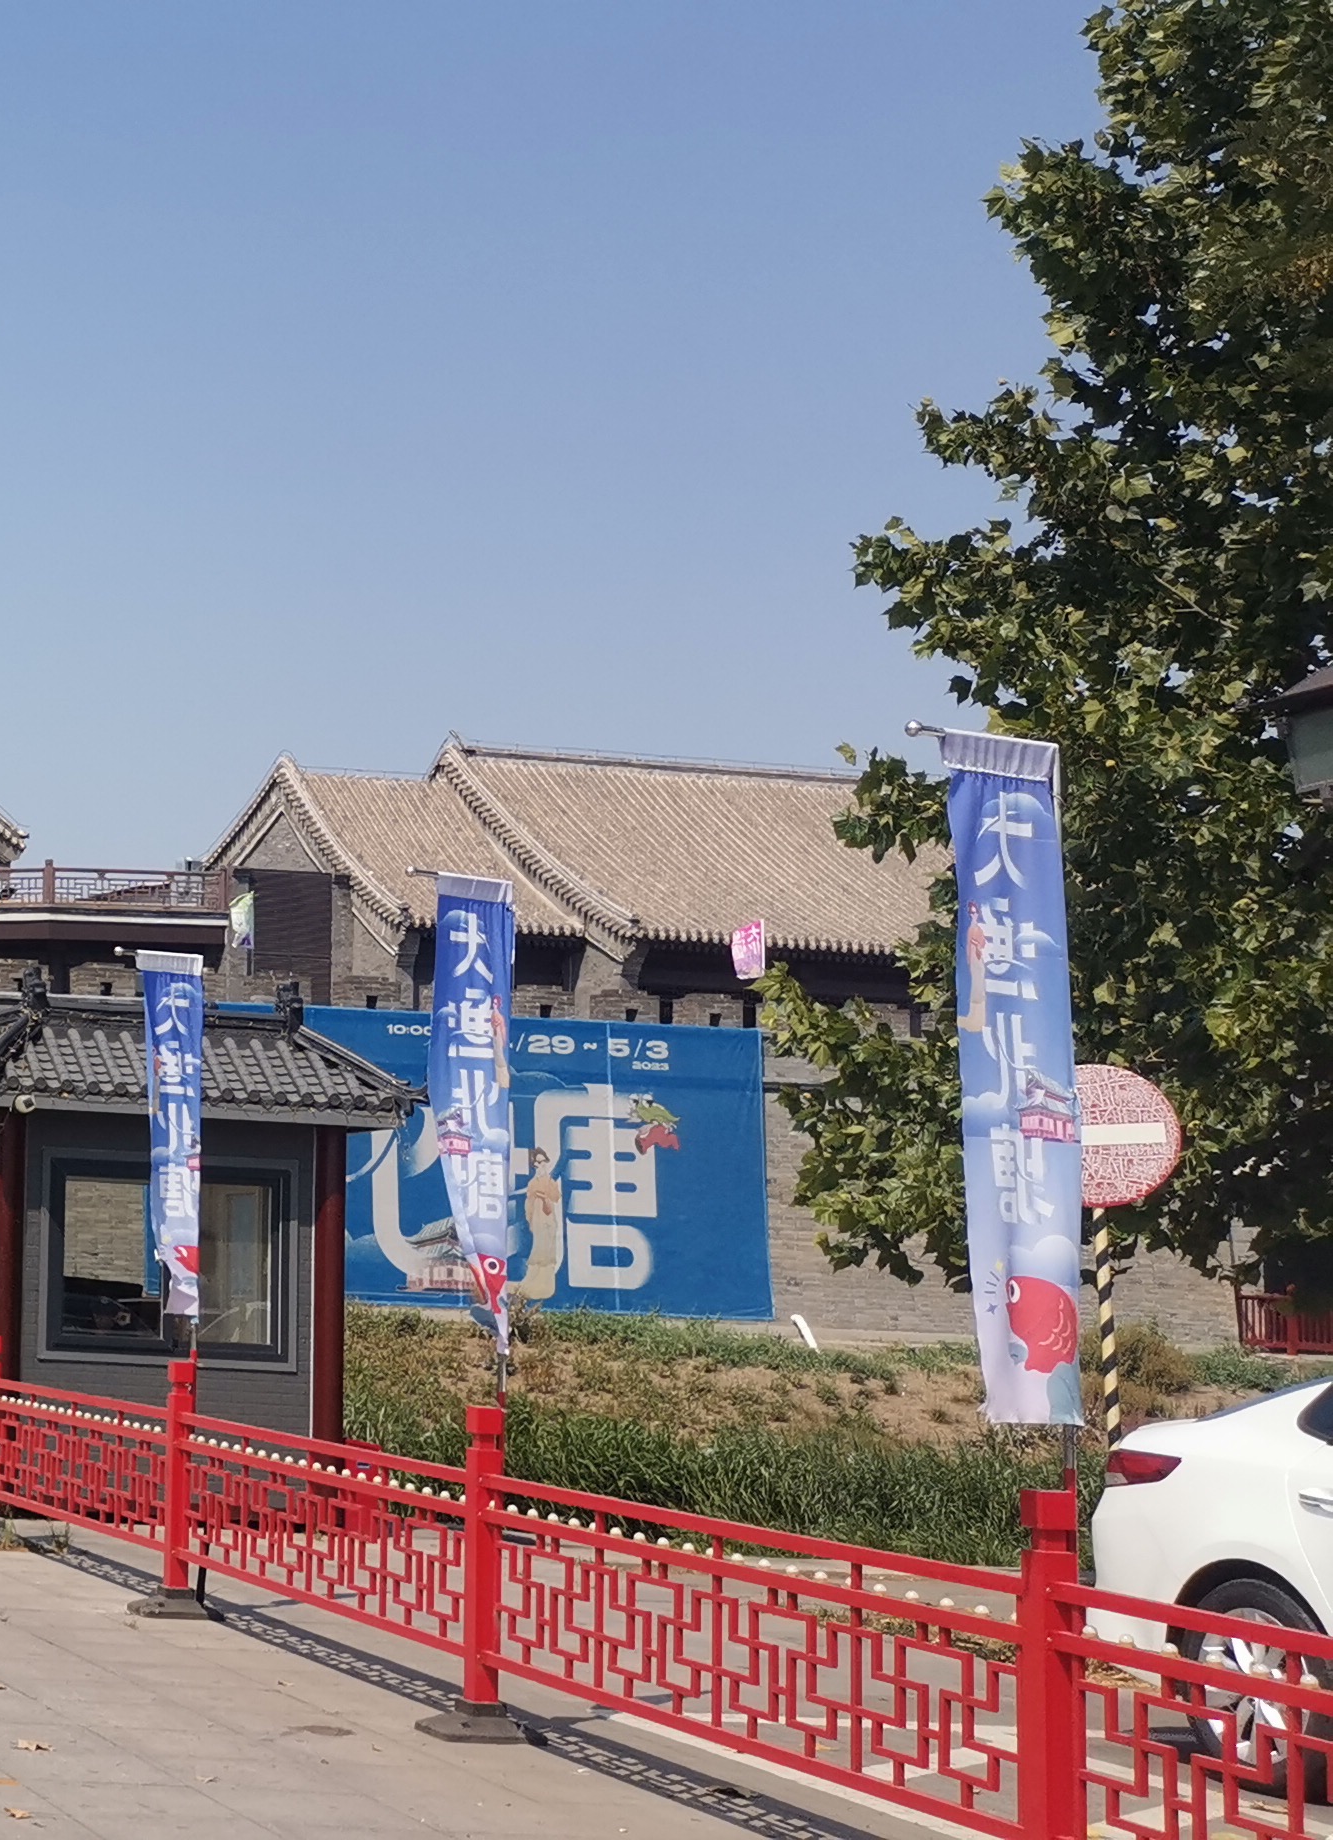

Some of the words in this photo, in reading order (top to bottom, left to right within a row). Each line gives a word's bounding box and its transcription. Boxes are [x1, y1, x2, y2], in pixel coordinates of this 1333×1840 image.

[509, 1033, 576, 1055] /29
[607, 1037, 670, 1060] 5/3
[448, 912, 505, 1220] 大渔北塘
[631, 1060, 670, 1071] 2023
